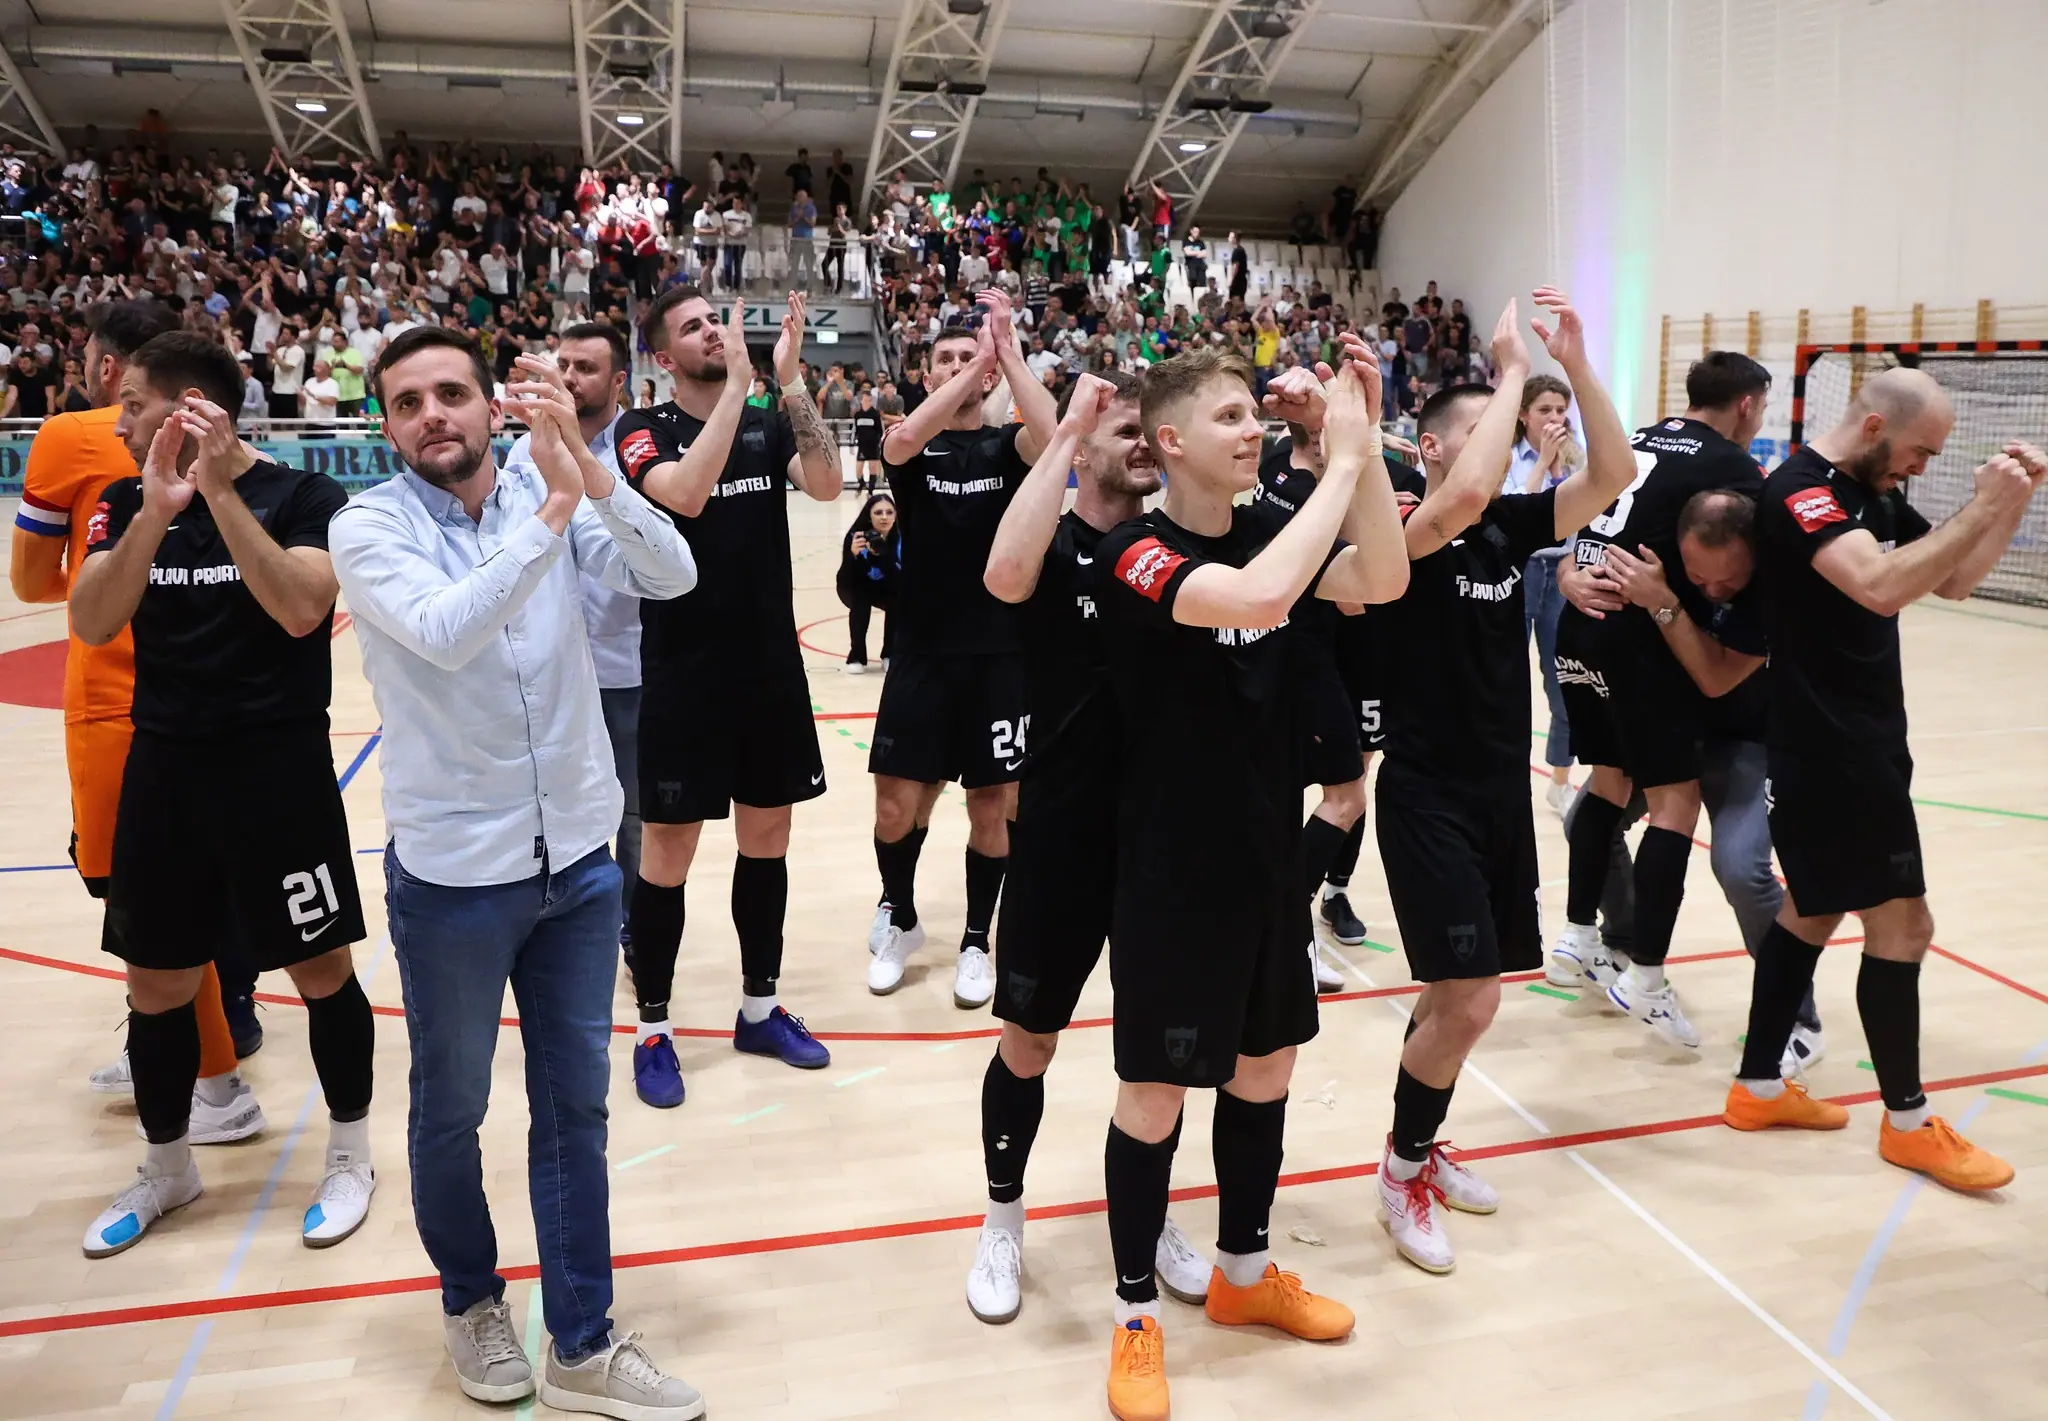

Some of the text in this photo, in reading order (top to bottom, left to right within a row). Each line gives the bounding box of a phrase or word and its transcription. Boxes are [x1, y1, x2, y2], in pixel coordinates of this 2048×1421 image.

[722, 307, 838, 327] IZLZ
[150, 567, 189, 585] PLAVI
[282, 863, 340, 925] 21
